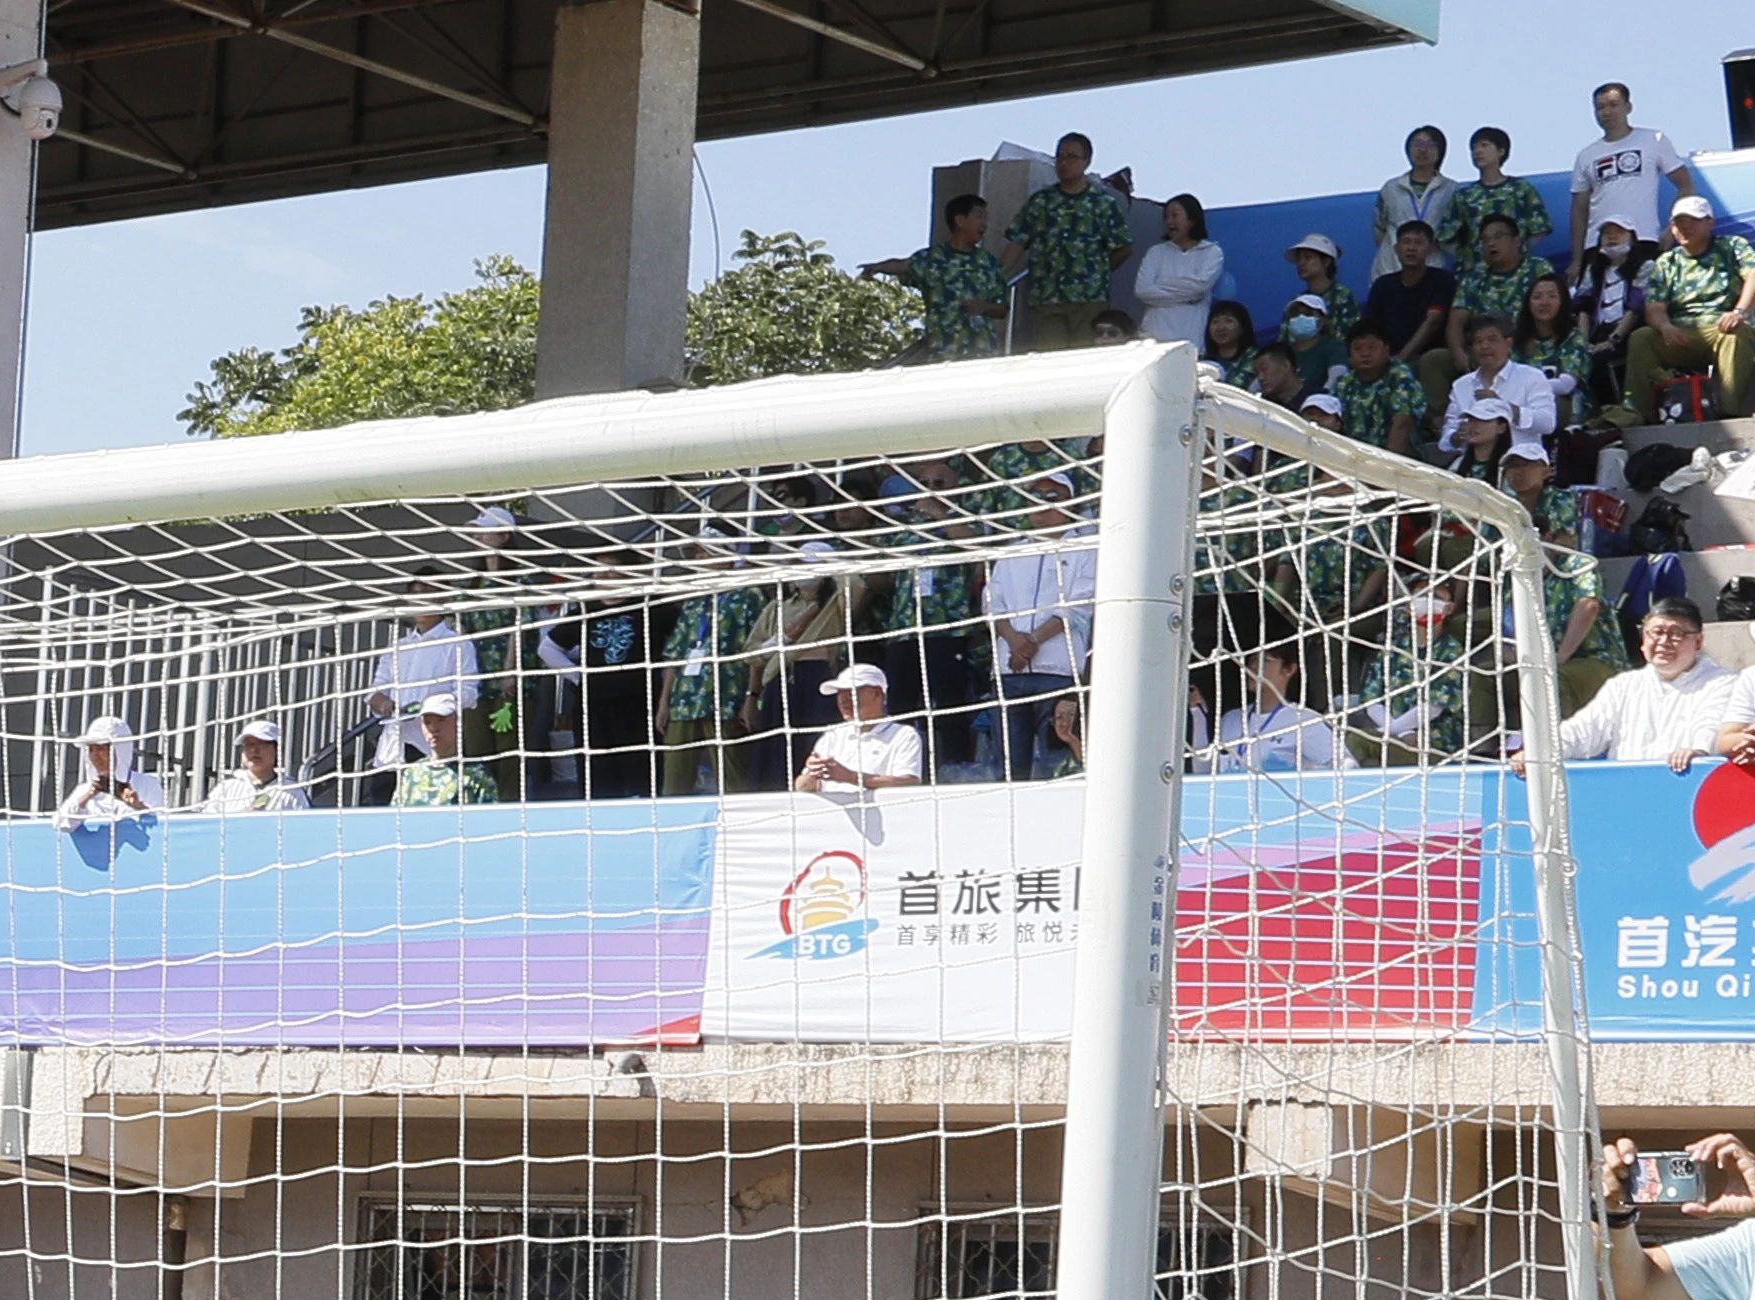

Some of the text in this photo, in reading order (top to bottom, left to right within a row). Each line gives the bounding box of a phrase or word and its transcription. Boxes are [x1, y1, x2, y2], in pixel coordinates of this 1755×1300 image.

[898, 867, 1081, 916] 首旅集
[798, 933, 852, 956] BTG
[897, 923, 998, 946] 首享精彩
[1617, 914, 1755, 968] 首汽
[1617, 974, 1699, 999] Shou
